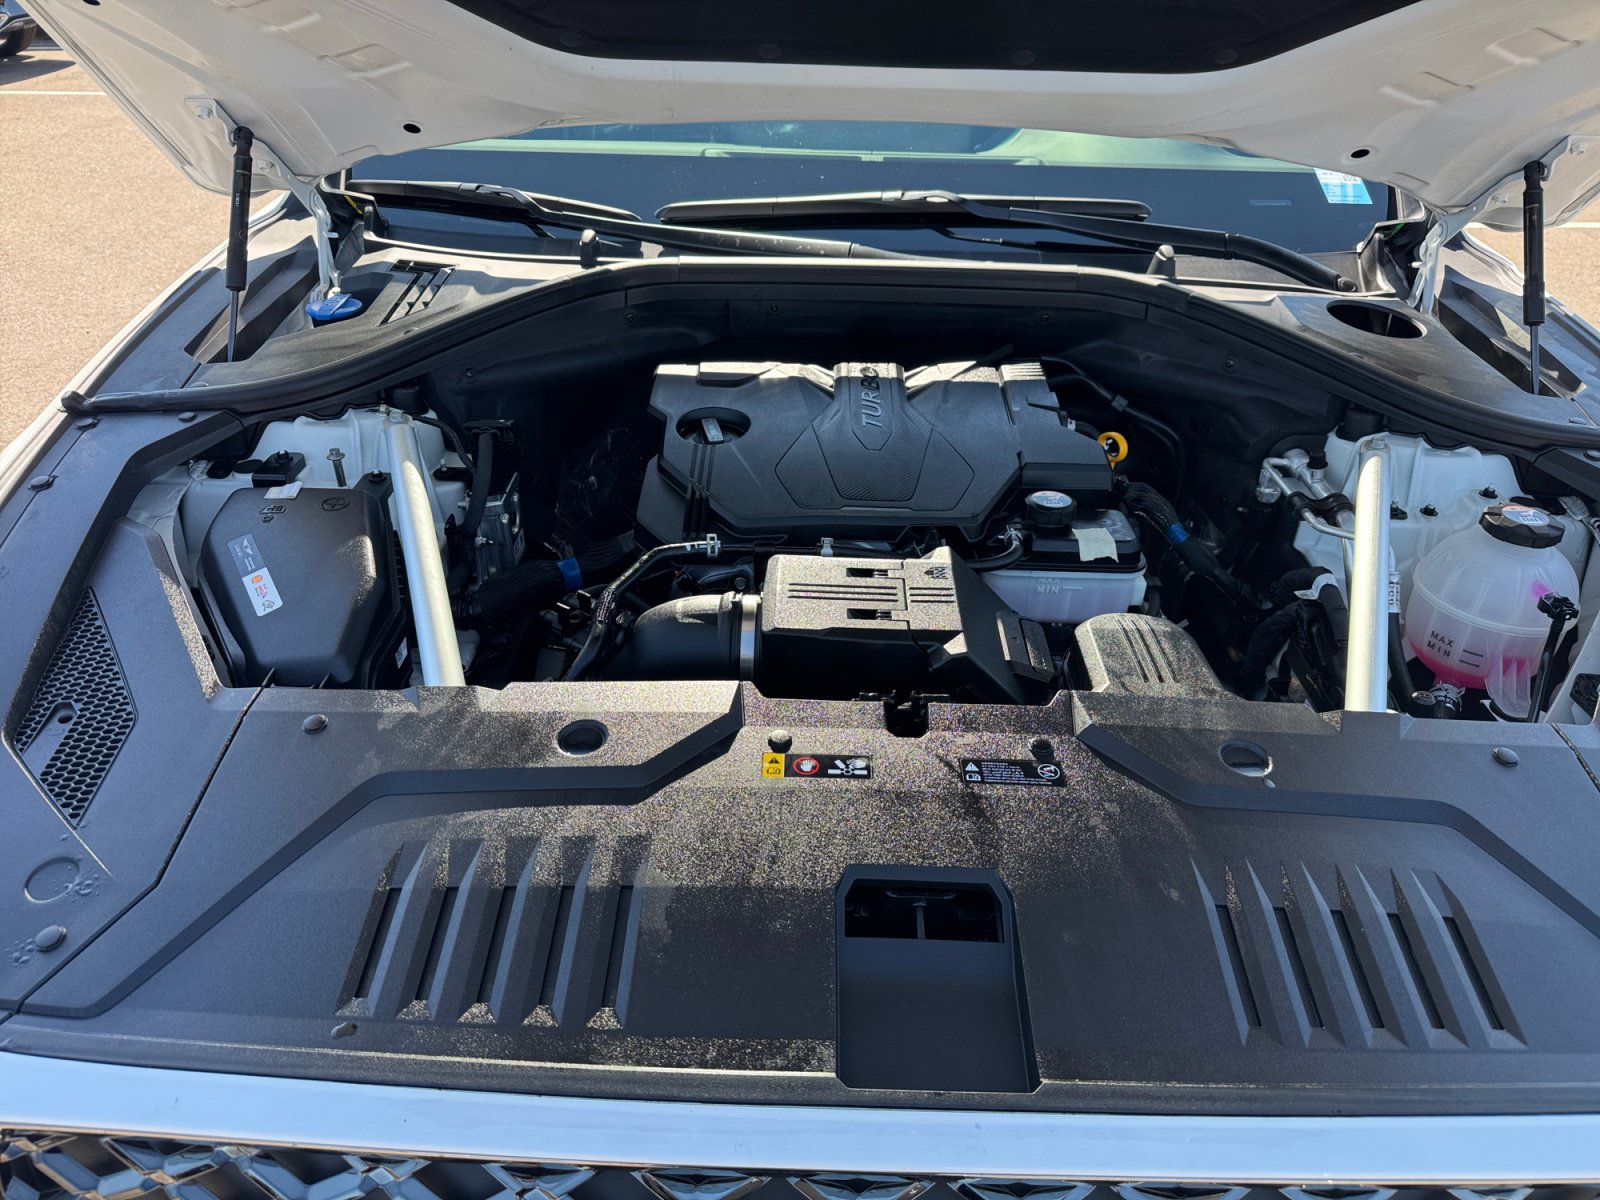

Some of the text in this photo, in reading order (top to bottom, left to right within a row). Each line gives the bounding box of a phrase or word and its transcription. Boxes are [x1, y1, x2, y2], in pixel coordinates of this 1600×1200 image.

[860, 366, 883, 428] TURBO
[1036, 584, 1060, 594] MIN
[1430, 630, 1454, 648] MAX
[1426, 640, 1451, 658] MIN
